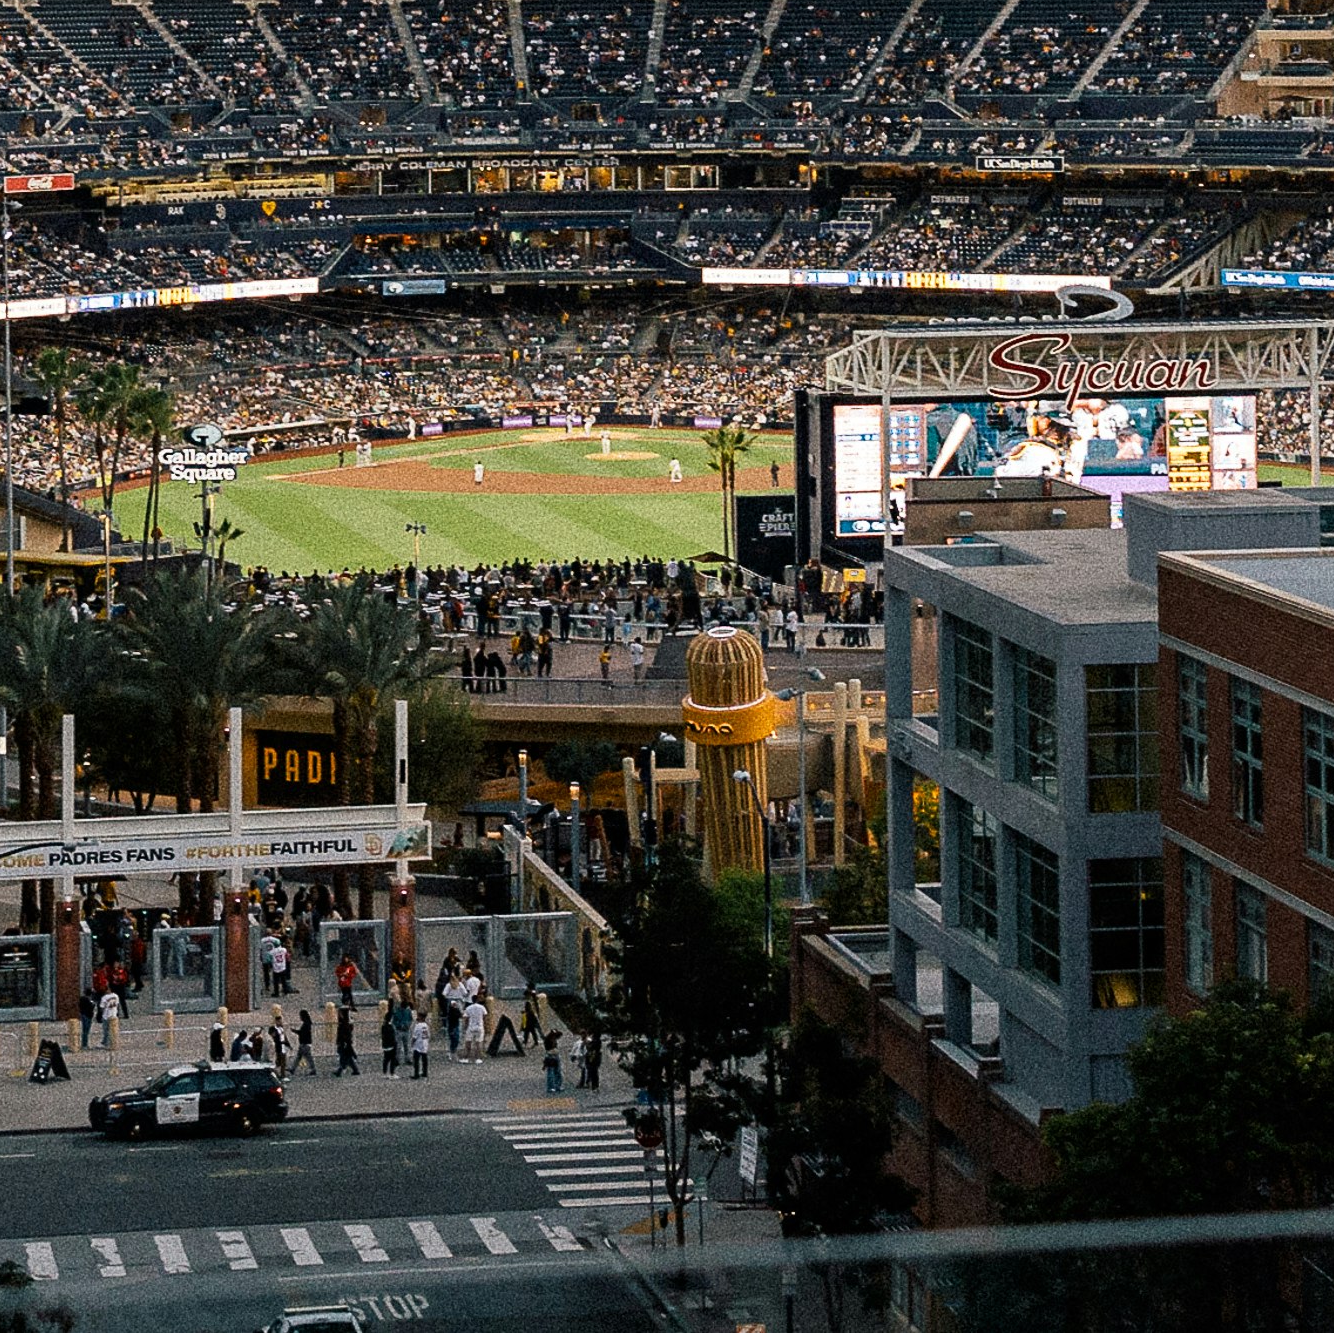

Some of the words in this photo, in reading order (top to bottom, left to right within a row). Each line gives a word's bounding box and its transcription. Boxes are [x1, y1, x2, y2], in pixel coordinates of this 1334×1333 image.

[351, 162, 393, 172] JERRY
[399, 160, 467, 170] COLEMAN
[471, 158, 559, 169] BROADCAST
[564, 157, 620, 167] CENTER
[930, 195, 970, 204] CUTWATER
[1062, 196, 1104, 206] CUTWATER
[167, 206, 184, 216] RAK
[987, 332, 1218, 414] Sycuan
[157, 448, 248, 468] Gallagher
[170, 464, 236, 484] Square
[761, 513, 795, 523] CRAFT
[767, 522, 790, 532] PIER
[48, 849, 122, 867] PADRES
[125, 847, 176, 864] FANS
[338, 1293, 430, 1321] STOP
